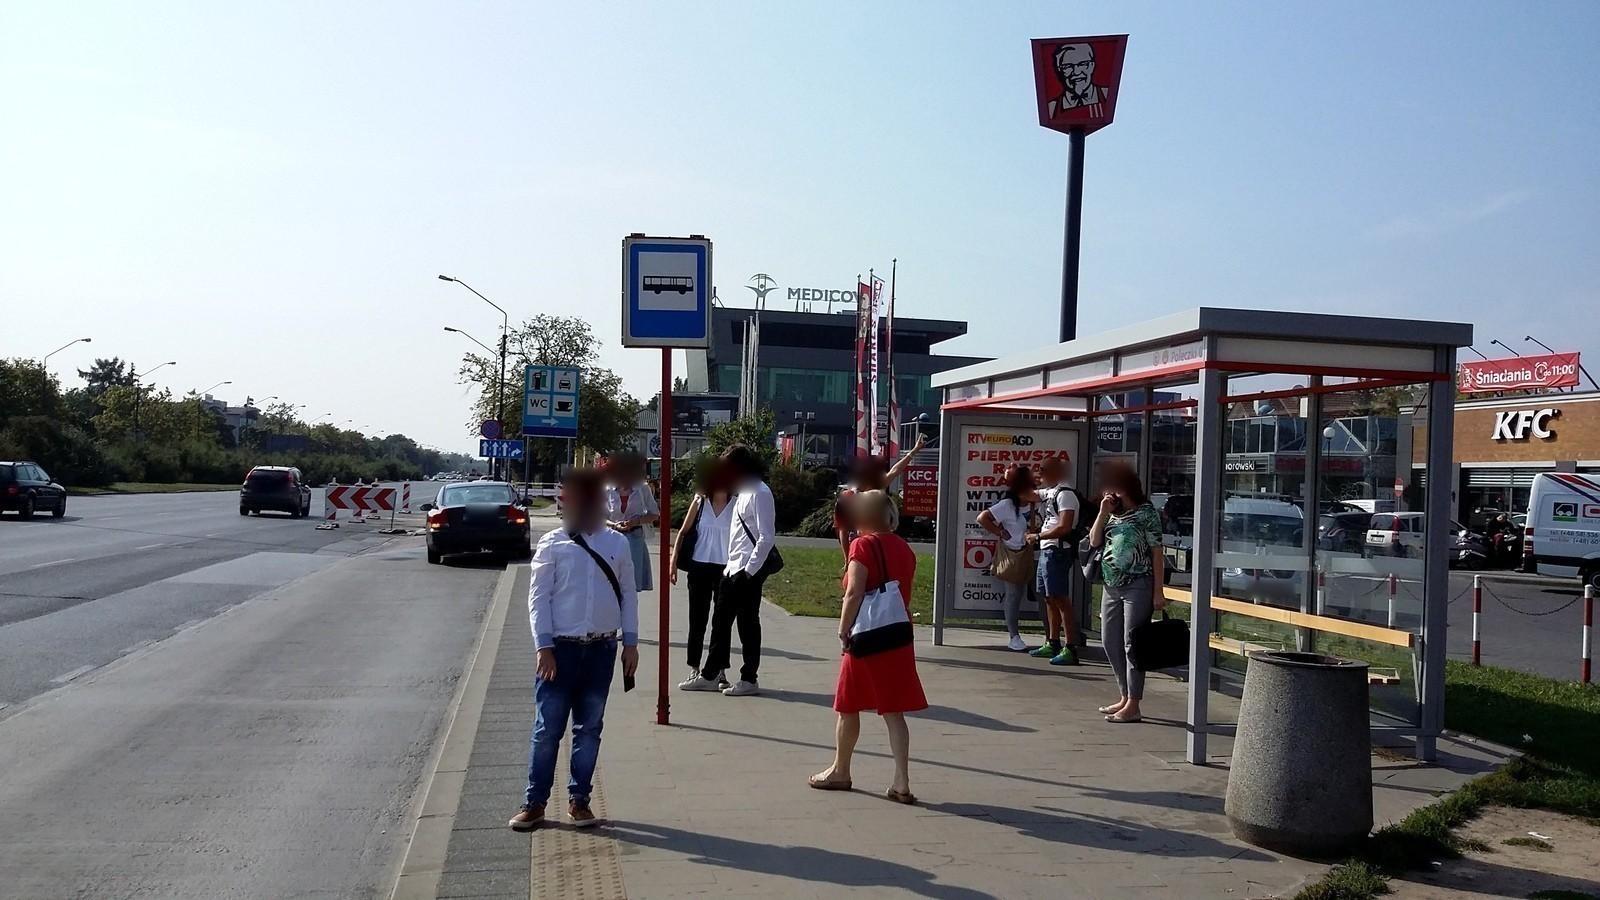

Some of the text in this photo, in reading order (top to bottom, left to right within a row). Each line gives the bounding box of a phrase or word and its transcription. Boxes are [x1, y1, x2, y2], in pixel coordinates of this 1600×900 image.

[1476, 368, 1532, 385] Śniadania
[1551, 364, 1576, 376] 11:00
[530, 398, 548, 409] WC
[1491, 408, 1553, 440] KFC
[967, 450, 1071, 461] PIERWSZA
[907, 470, 932, 481] KFC
[966, 490, 983, 500] W
[962, 589, 1006, 603] Galaxy
